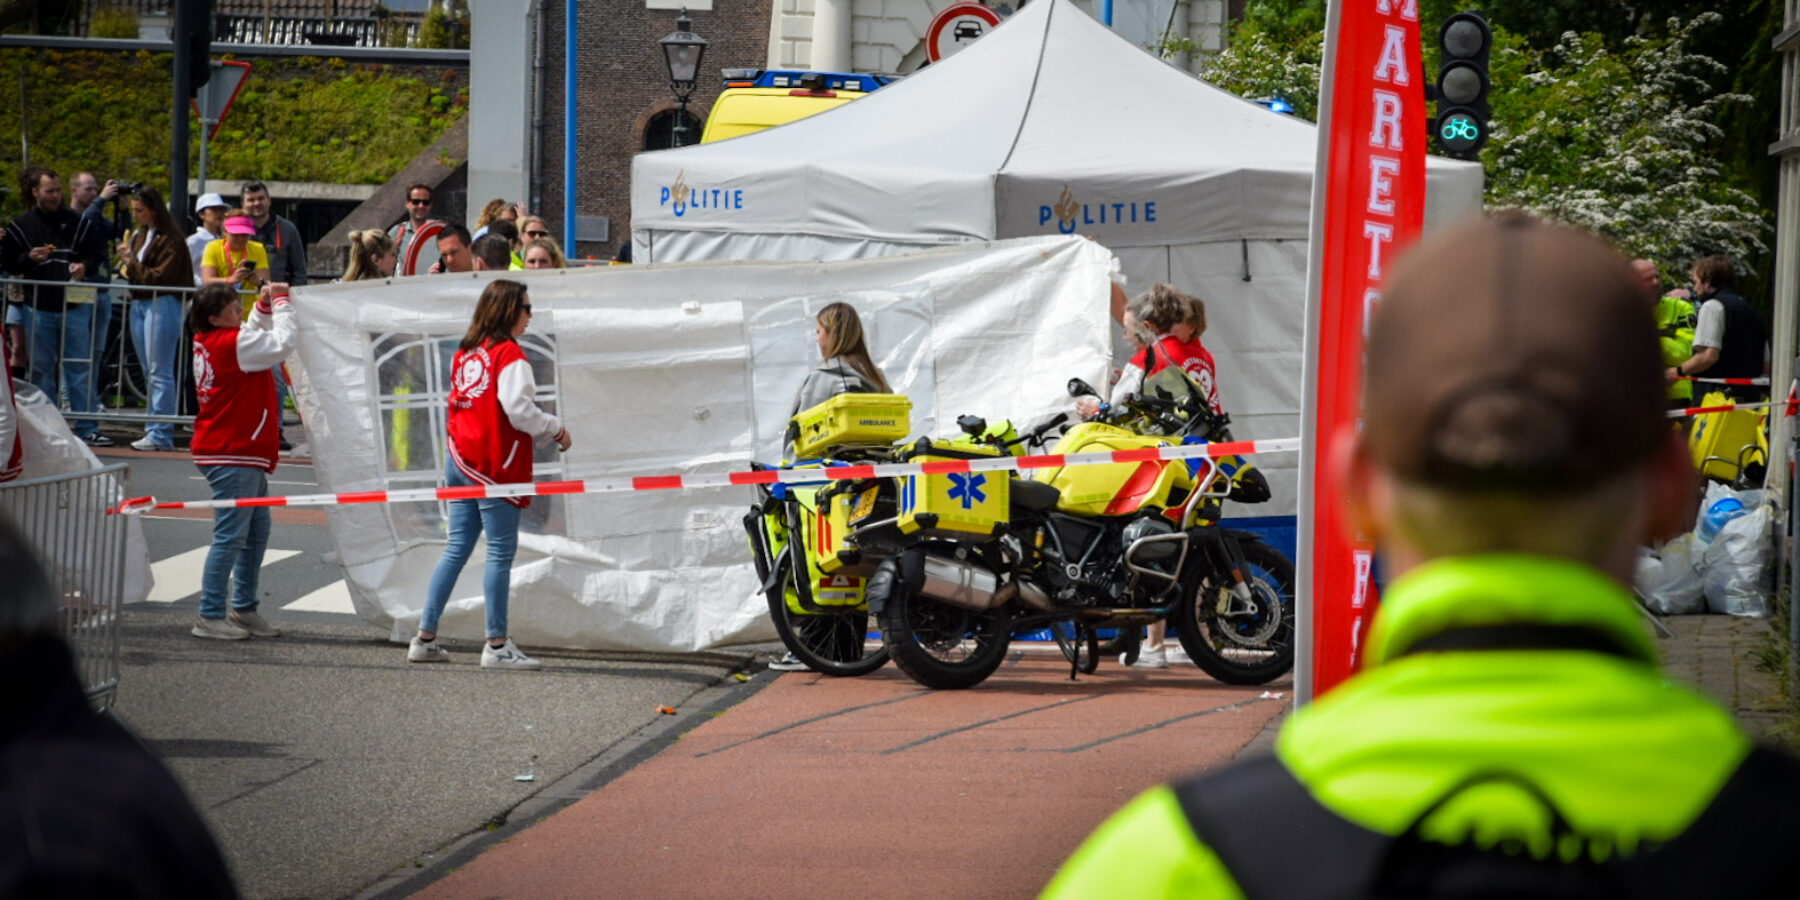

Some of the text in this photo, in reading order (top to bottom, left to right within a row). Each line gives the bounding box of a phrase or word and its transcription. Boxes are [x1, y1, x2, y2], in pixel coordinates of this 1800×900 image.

[660, 186, 743, 217] POLITIE
[1039, 202, 1156, 234] POLITIE
[859, 419, 896, 427] AMBULANCE
